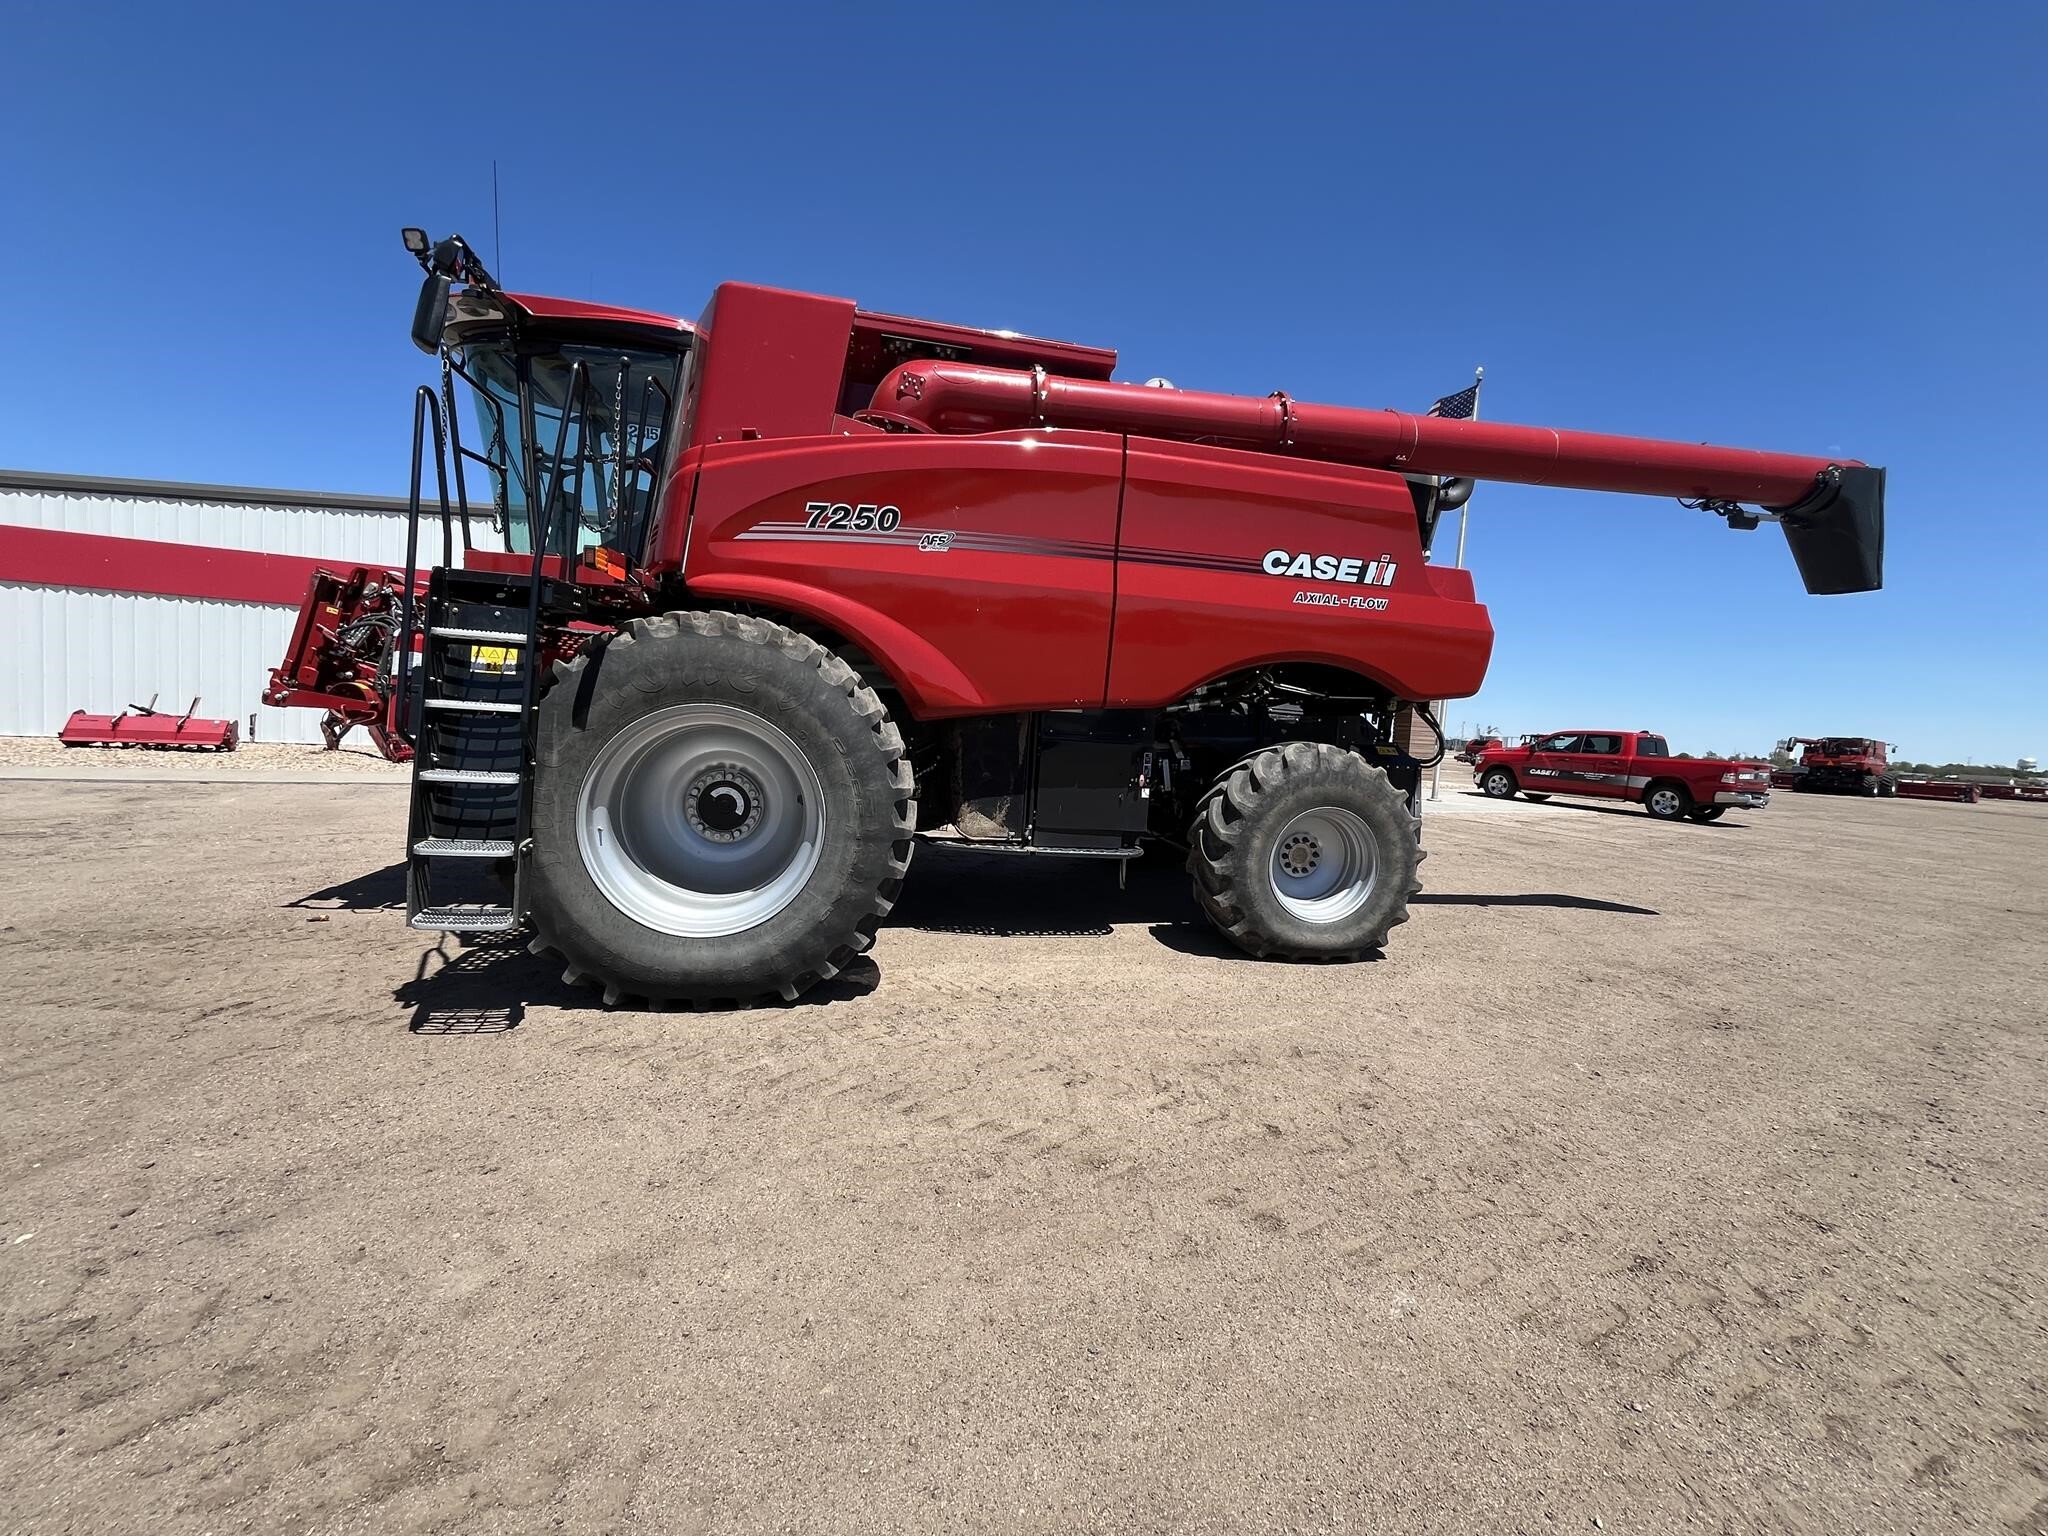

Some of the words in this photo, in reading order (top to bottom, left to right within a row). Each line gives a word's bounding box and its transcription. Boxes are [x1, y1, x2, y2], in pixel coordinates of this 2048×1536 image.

[806, 502, 900, 532] 7250
[920, 534, 949, 546] AFS
[1262, 549, 1363, 583] CASE
[1529, 768, 1552, 776] CASE
